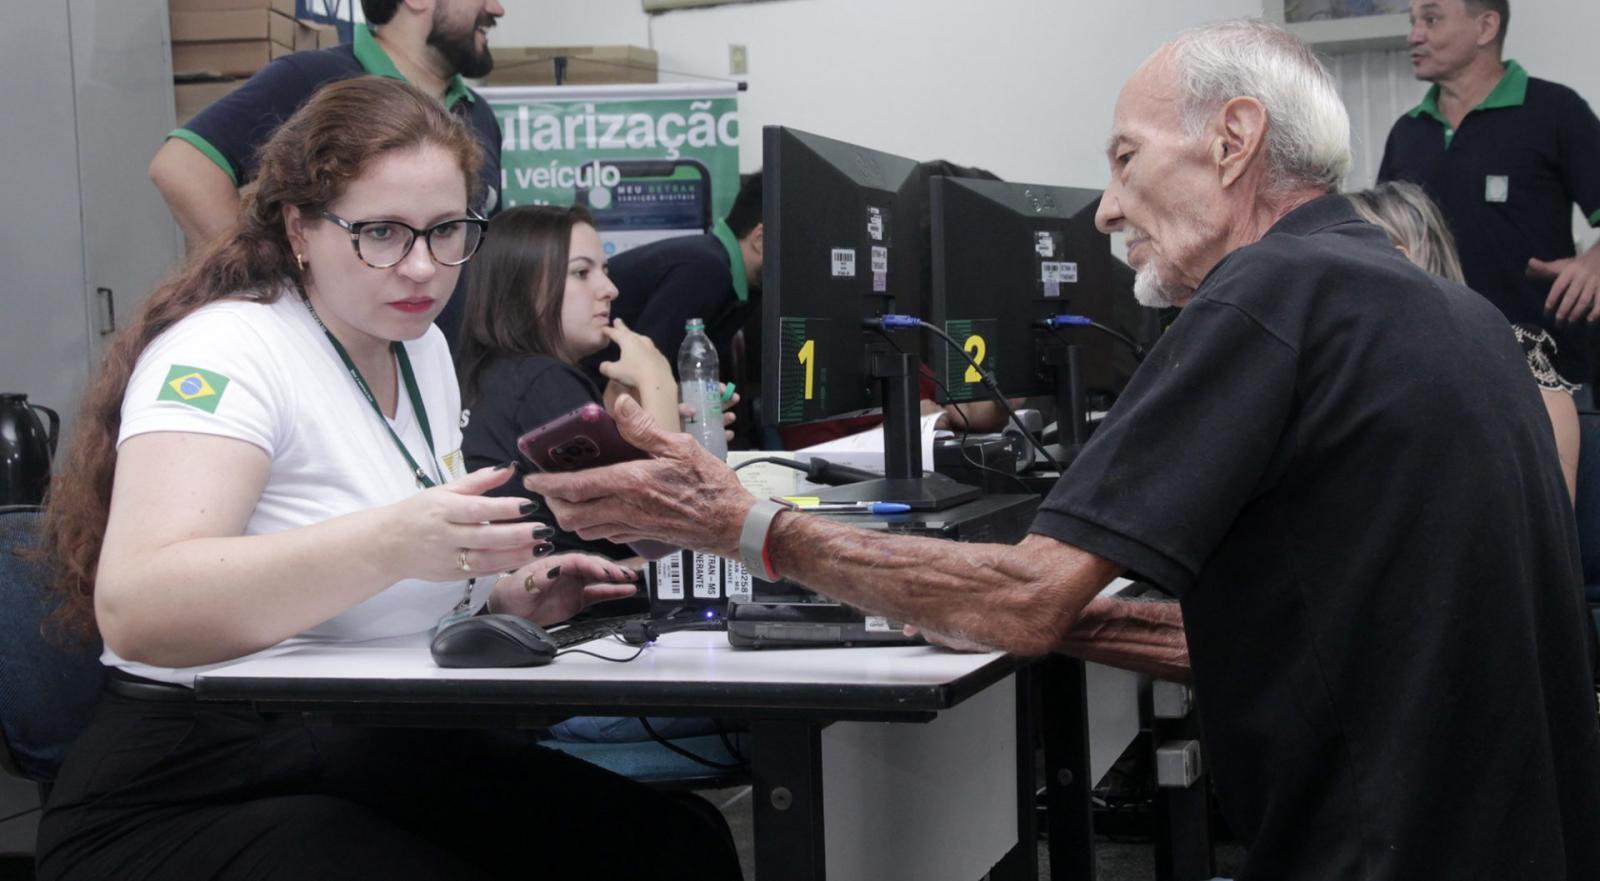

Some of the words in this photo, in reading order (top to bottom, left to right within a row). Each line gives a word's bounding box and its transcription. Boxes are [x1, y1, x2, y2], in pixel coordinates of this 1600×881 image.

[515, 160, 621, 189] veículo
[617, 185, 642, 195] MEU
[648, 184, 696, 194] DETRAN
[797, 339, 815, 400] 1
[963, 334, 987, 383] 2
[696, 553, 704, 589] NERANTE
[708, 555, 716, 576] TRAN
[708, 583, 716, 595] MS
